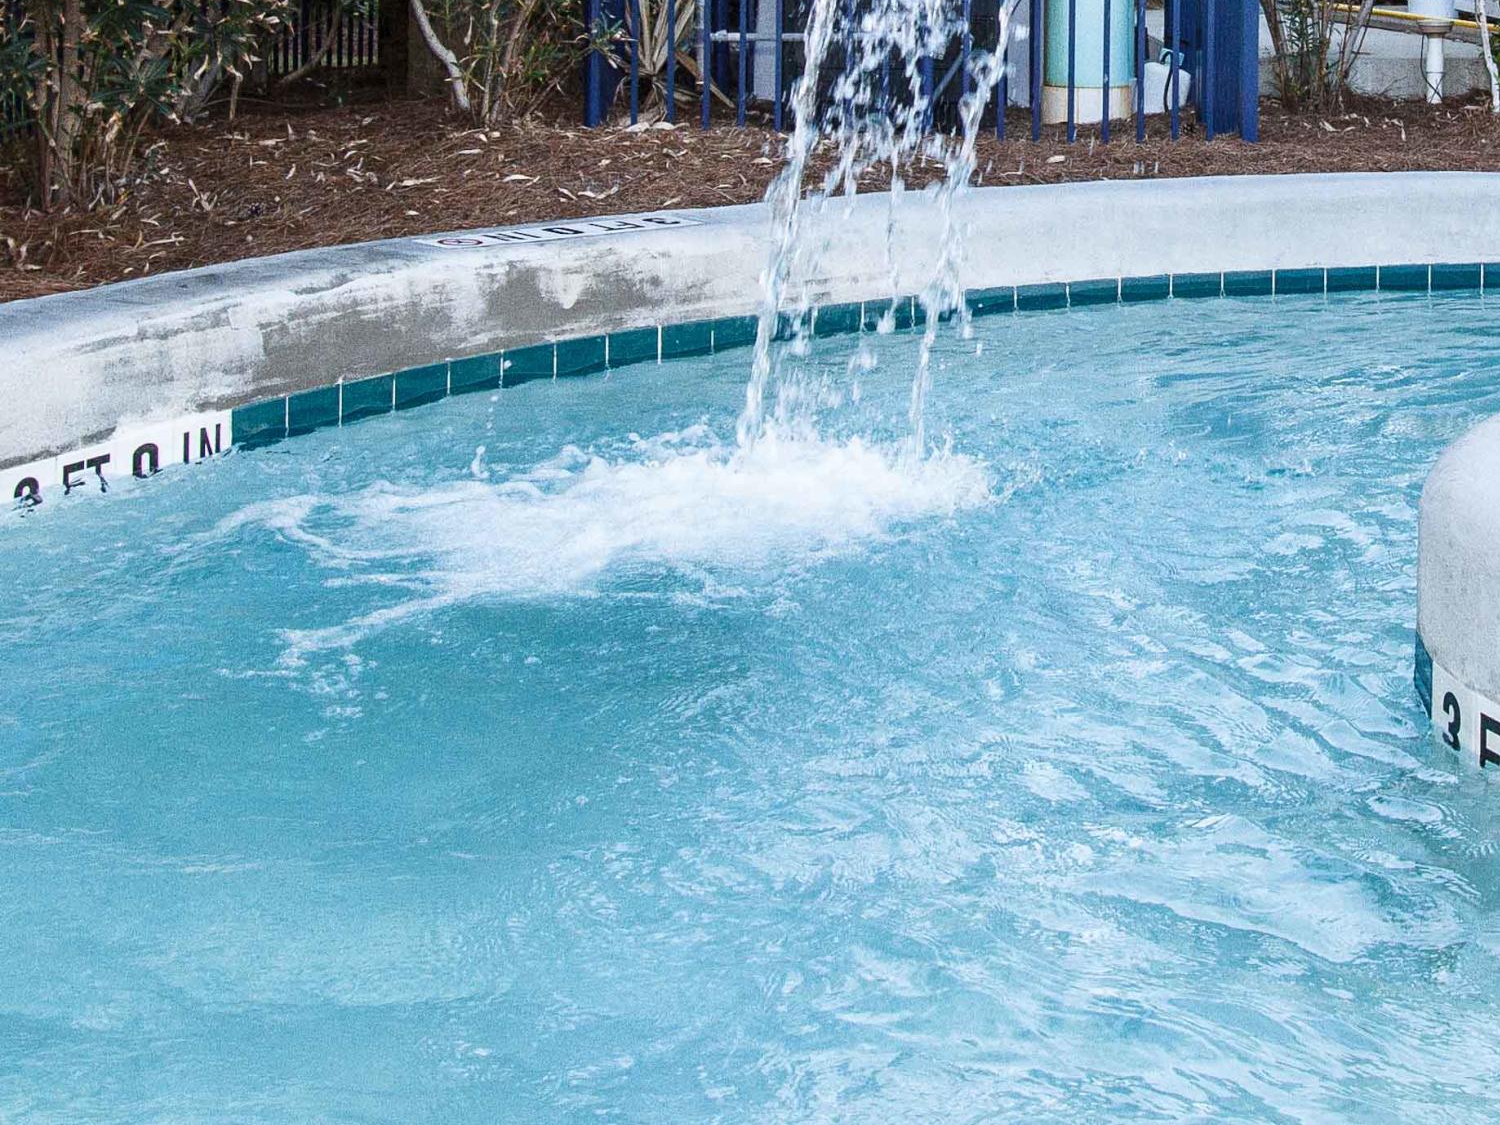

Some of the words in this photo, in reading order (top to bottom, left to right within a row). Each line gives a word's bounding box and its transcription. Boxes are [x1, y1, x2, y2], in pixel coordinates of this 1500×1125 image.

[485, 231, 540, 242] IN
[589, 221, 645, 231] FT
[183, 423, 221, 464] IN
[1442, 691, 1461, 751] 3
